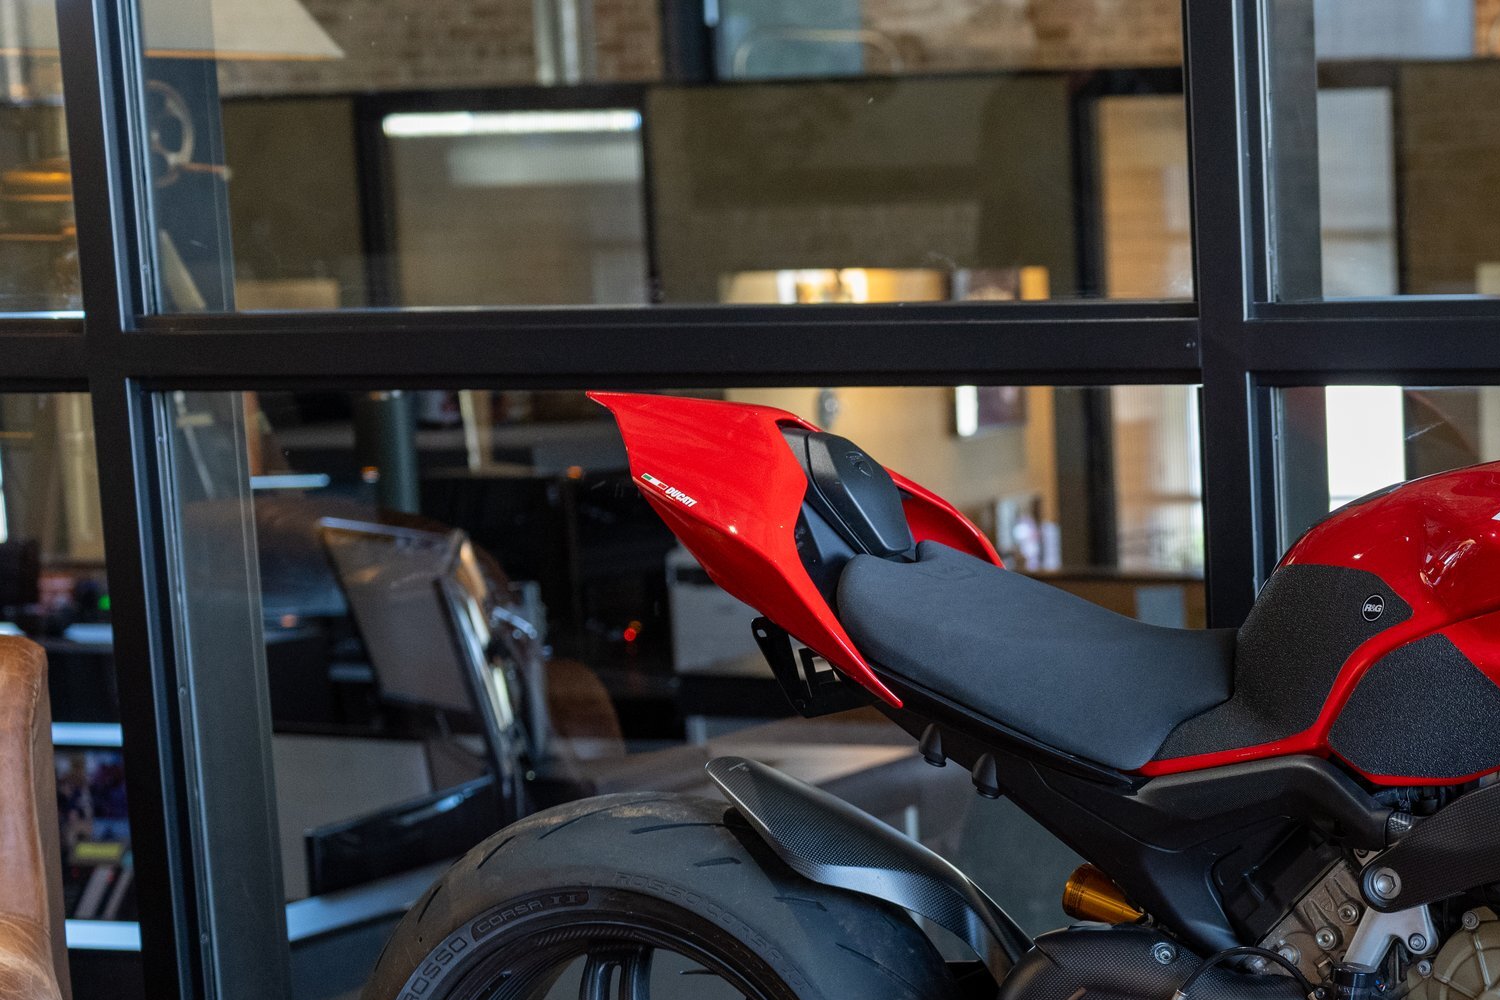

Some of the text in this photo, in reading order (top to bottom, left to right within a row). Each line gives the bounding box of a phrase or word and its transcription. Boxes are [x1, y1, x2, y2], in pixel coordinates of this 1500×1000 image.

[665, 486, 698, 507] DUCATI
[1364, 602, 1383, 613] R&G
[475, 900, 546, 935] CORSA
